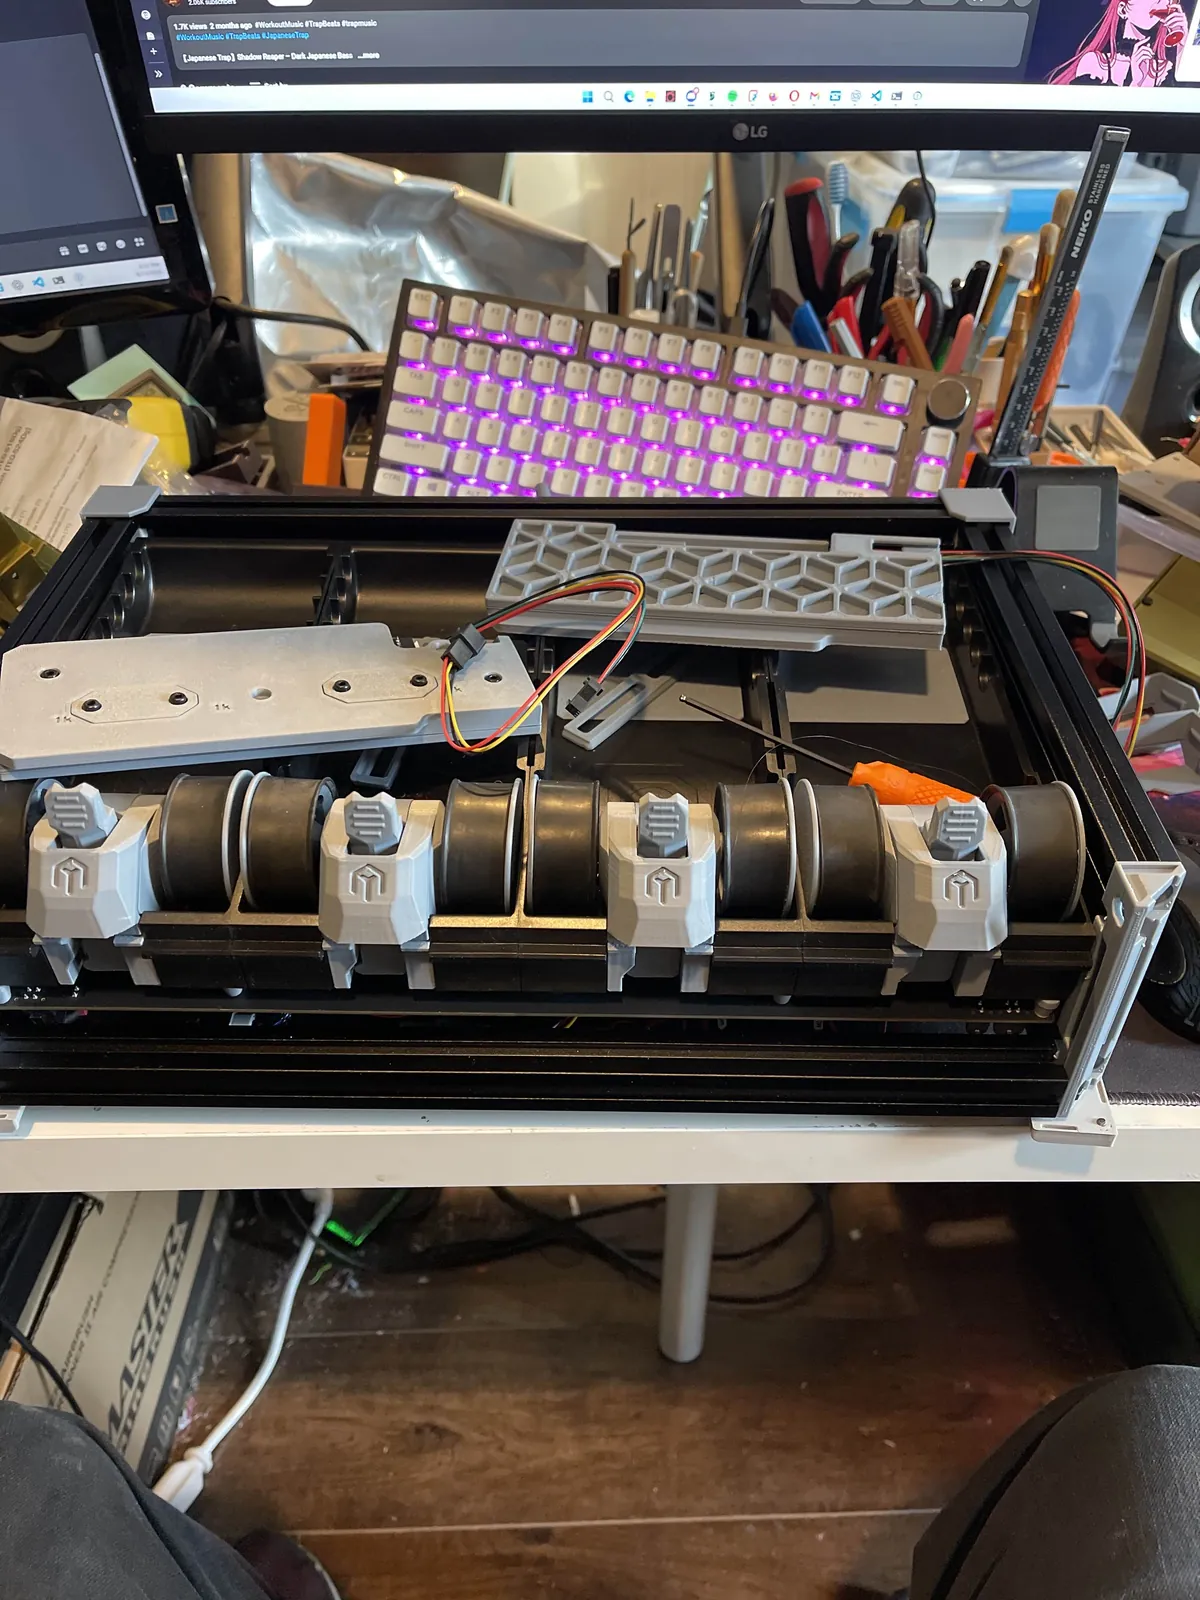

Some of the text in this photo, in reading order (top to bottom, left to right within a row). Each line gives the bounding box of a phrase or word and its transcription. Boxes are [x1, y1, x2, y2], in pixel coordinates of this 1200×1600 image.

[173, 19, 378, 31] 1.7K views 2 months ago #WorkoutMusic #TrapBeats #trapmusic
[176, 31, 310, 41] #WorkoutMusic #TrapBeats #JapaneseTrap
[237, 53, 262, 61] Shadow
[263, 53, 285, 61] Reaper
[291, 52, 307, 60] Dark
[307, 52, 337, 61] Japanese
[337, 52, 353, 60] Bass
[750, 125, 768, 138] LG
[1088, 163, 1106, 204] STAINLESS
[1092, 163, 1111, 205] HARDENED
[1070, 208, 1093, 259] NEIKO
